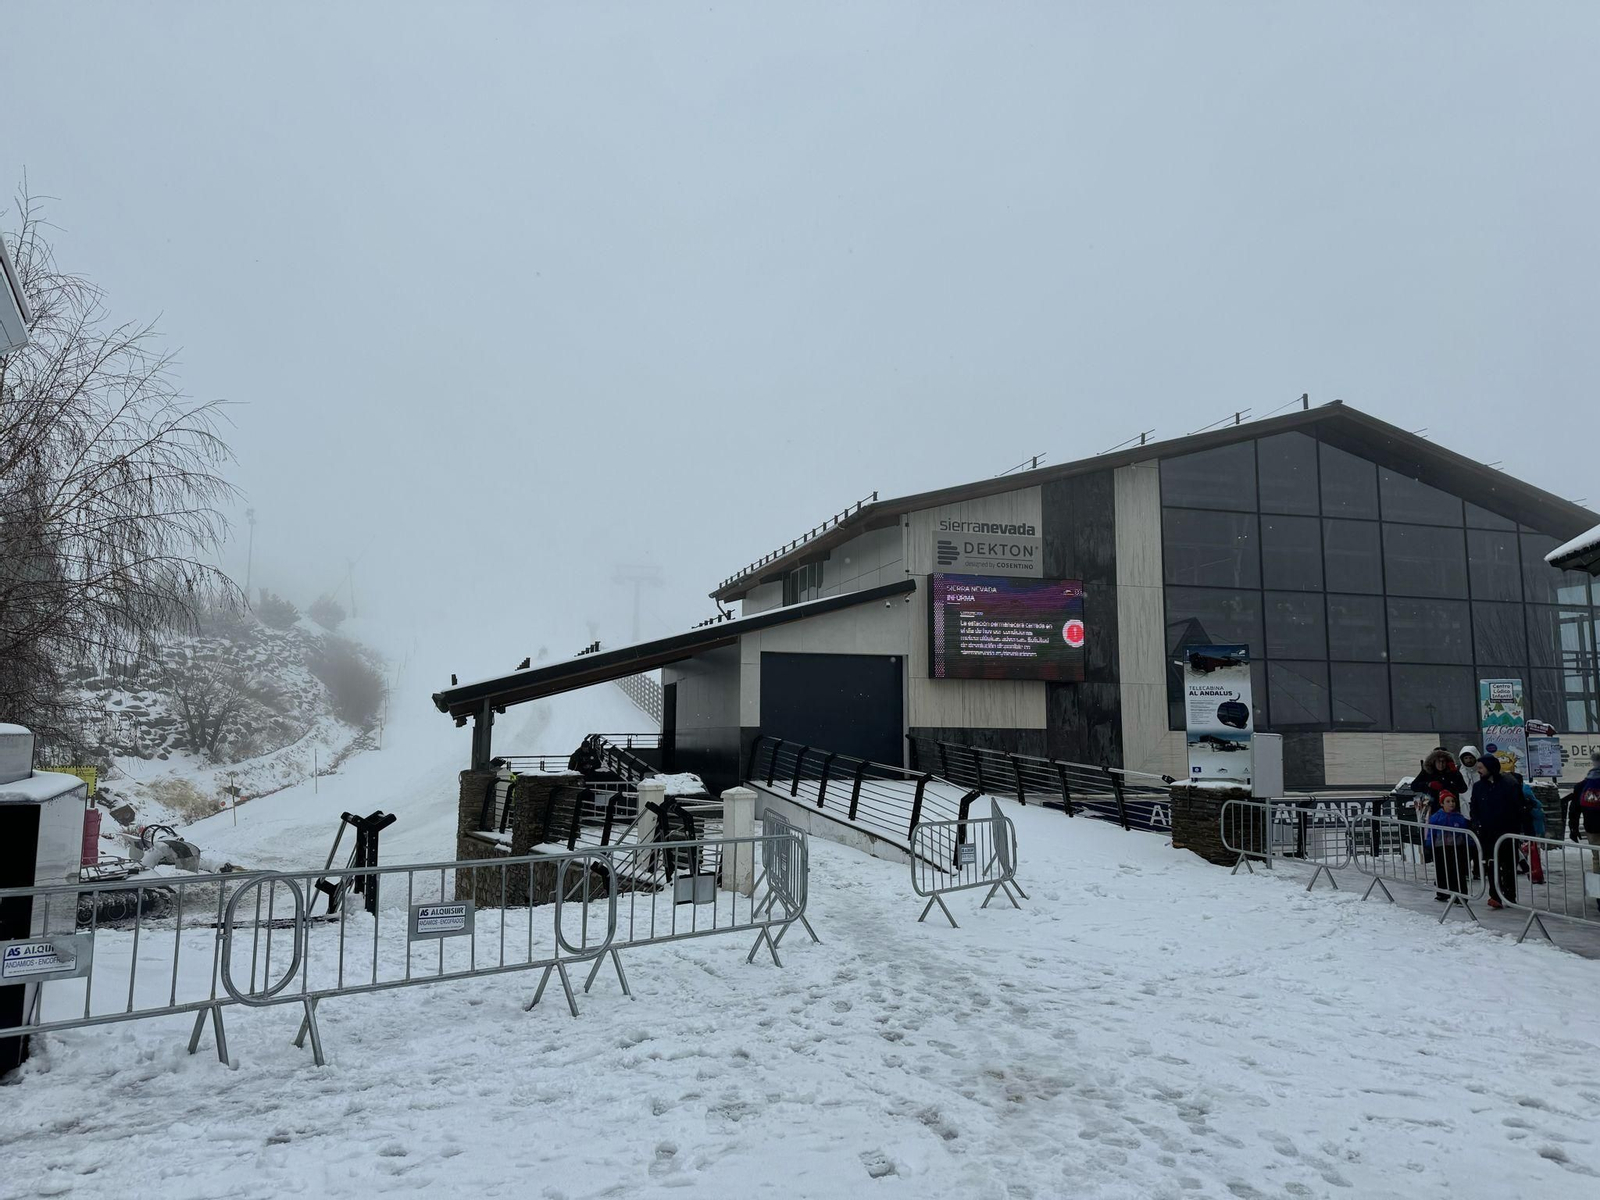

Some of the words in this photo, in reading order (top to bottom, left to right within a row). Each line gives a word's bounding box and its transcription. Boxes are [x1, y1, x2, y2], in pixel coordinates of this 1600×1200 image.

[939, 517, 1035, 536] sierranevada
[996, 562, 1034, 570] COSENTINO
[1486, 724, 1498, 735] El
[1499, 724, 1522, 735] Cole
[420, 908, 429, 917] AS
[430, 907, 464, 916] ALQUISUR
[7, 947, 21, 957] AS
[24, 944, 54, 955] ALQUI
[4, 959, 35, 969] ANDAMIOS
